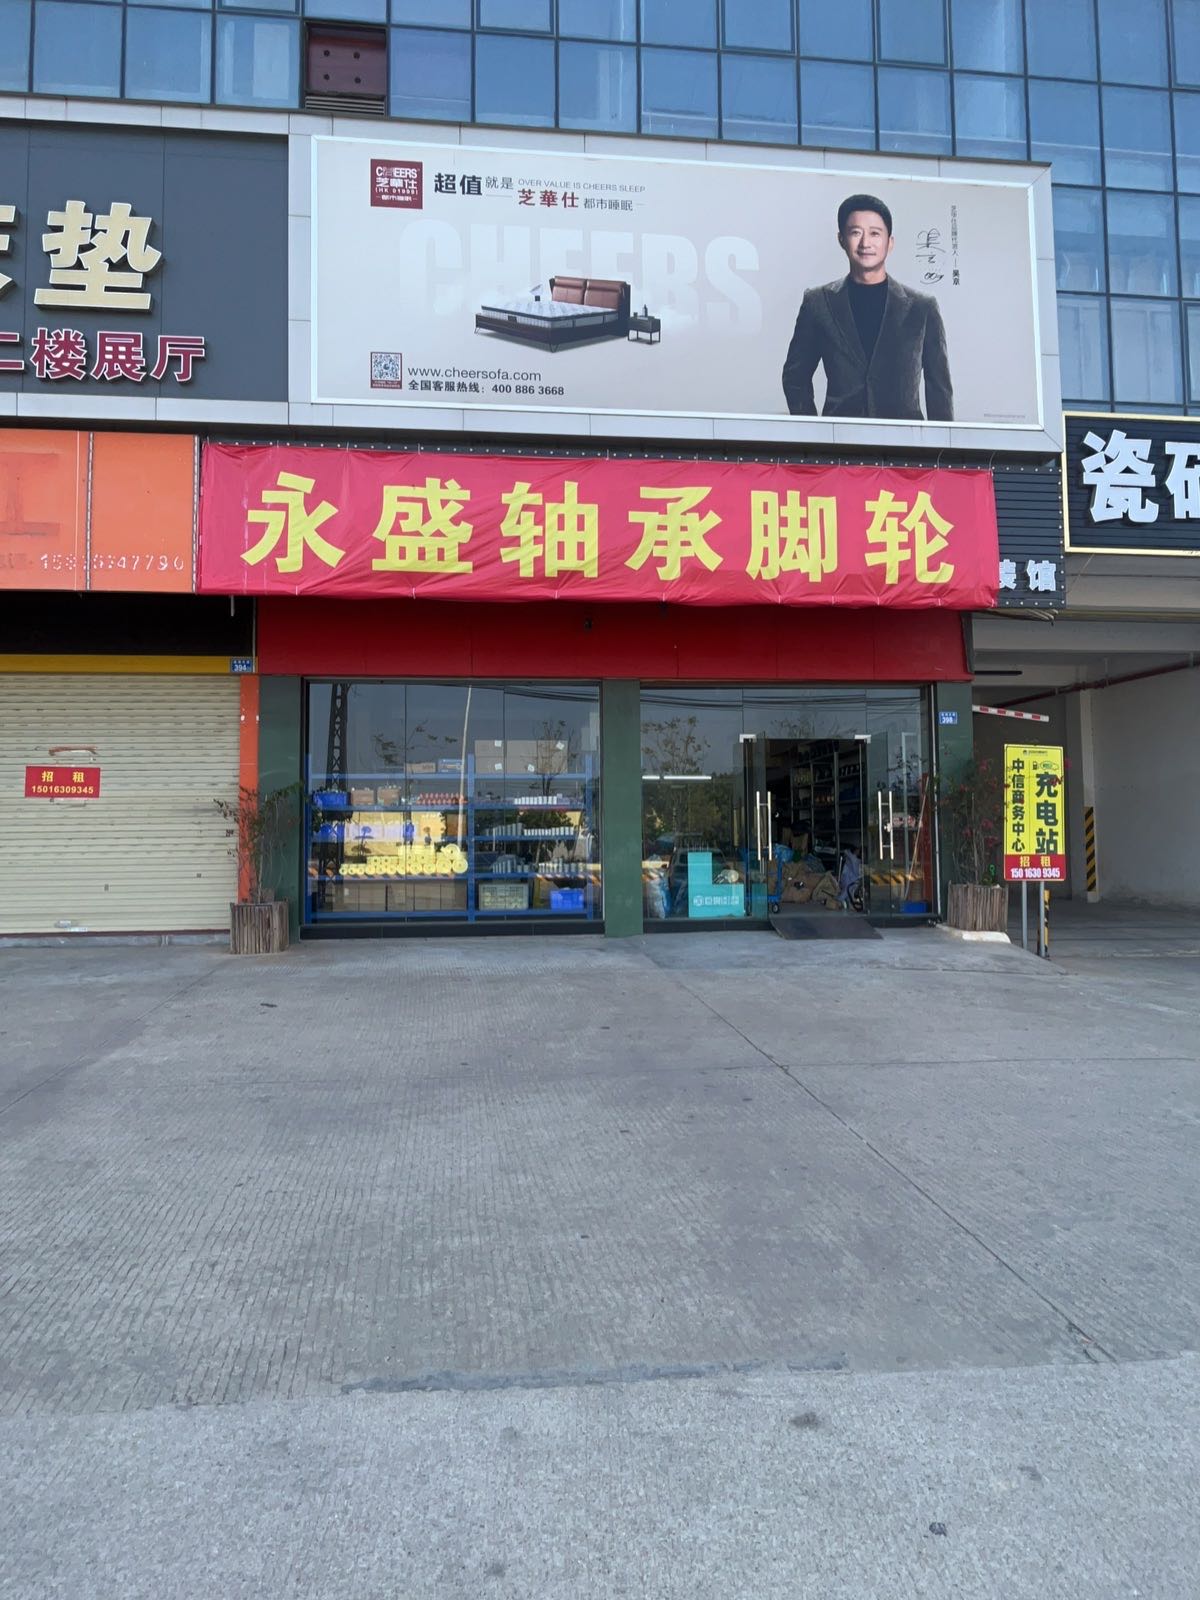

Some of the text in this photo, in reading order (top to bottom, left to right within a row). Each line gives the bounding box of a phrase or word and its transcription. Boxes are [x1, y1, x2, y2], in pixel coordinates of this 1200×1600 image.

[434, 172, 514, 196] 超值 就是
[518, 179, 542, 187] OVER
[544, 180, 570, 189] VALUE
[583, 183, 618, 192] CHEERS
[620, 184, 645, 193] SLEEP
[518, 188, 633, 211] 芝華仕 都市睡眠
[0, 200, 162, 310] 垫
[408, 366, 542, 382] www.cheersofa.com
[492, 384, 512, 394] 400
[515, 384, 535, 395] 886
[538, 386, 565, 396] 3668
[240, 471, 956, 585] 永盛轴承脚轮
[41, 770, 85, 783] 招租
[31, 785, 94, 794] 15016309345
[1011, 758, 1025, 852] 中信商务中心
[1035, 772, 1059, 854] 充电站
[1019, 856, 1051, 867] 招租
[1010, 868, 1060, 878] 150 1630 9345
